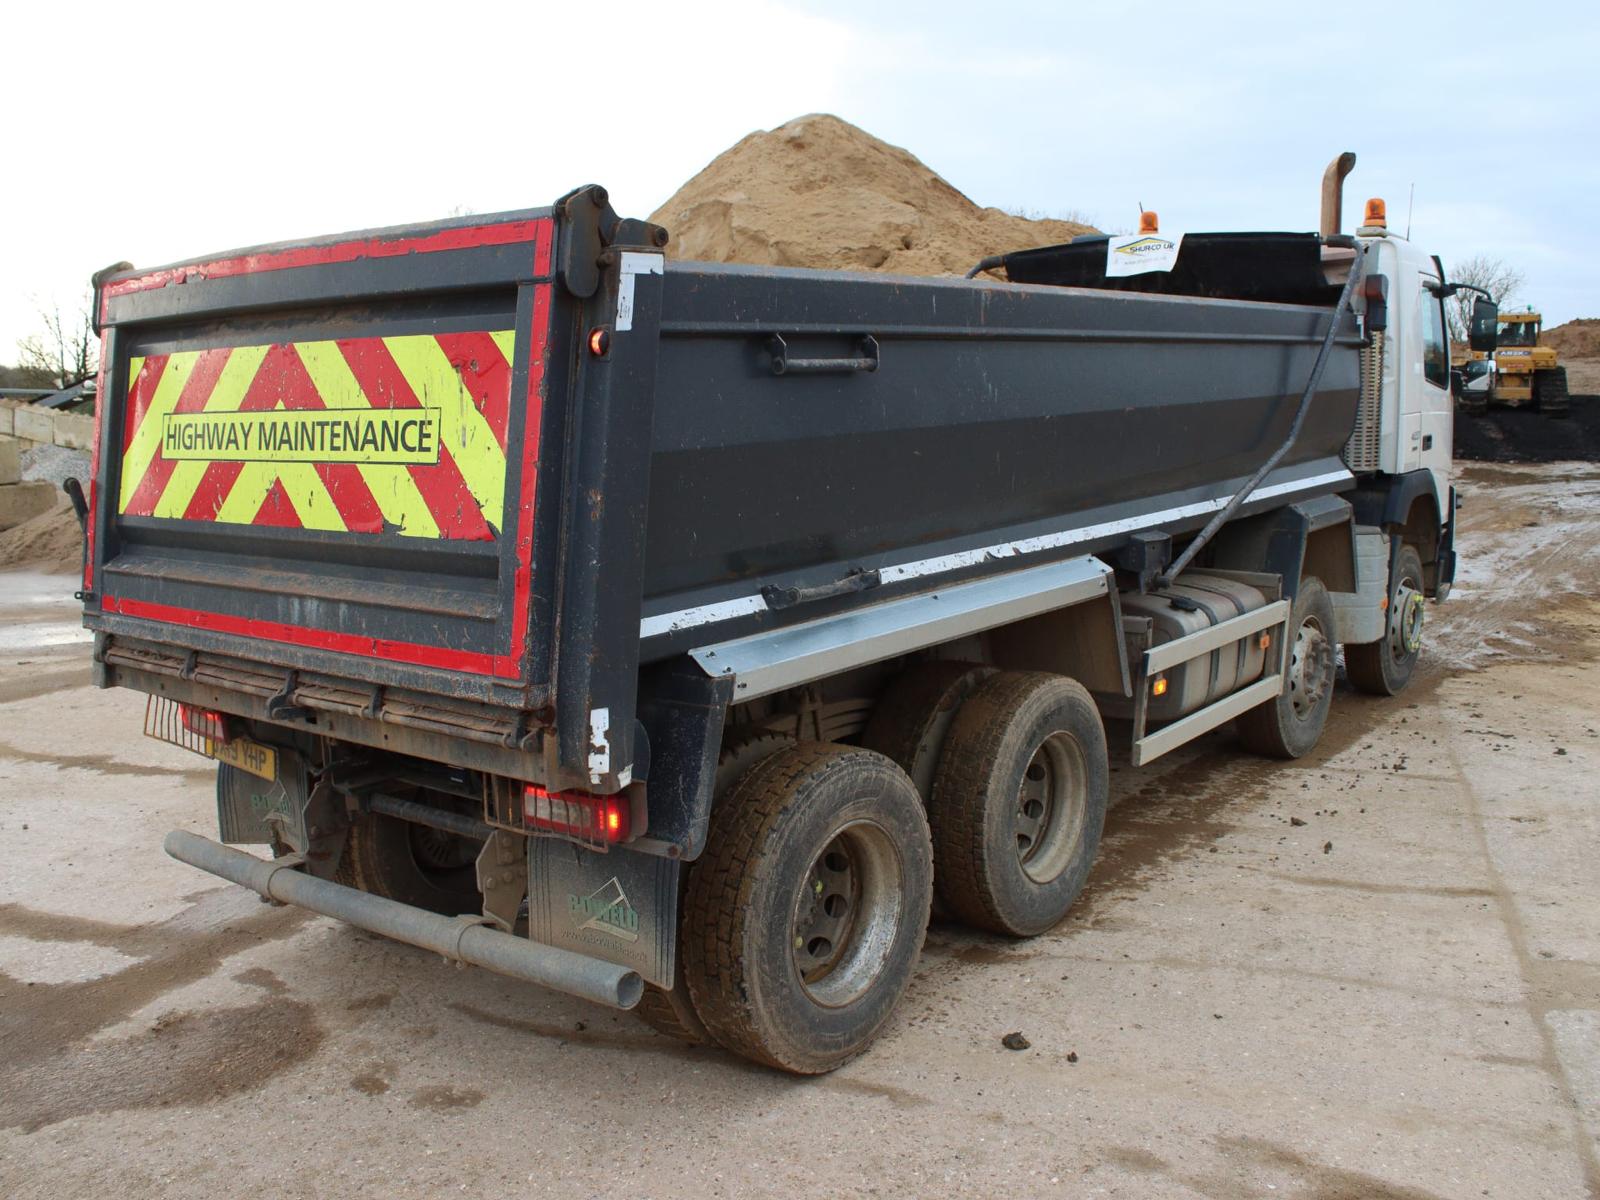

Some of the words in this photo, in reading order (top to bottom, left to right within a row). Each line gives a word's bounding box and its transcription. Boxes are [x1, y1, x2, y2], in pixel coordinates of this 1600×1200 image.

[165, 421, 253, 451] HIGHWAY
[258, 419, 433, 453] MAINTENANCE
[242, 742, 267, 771] YHP
